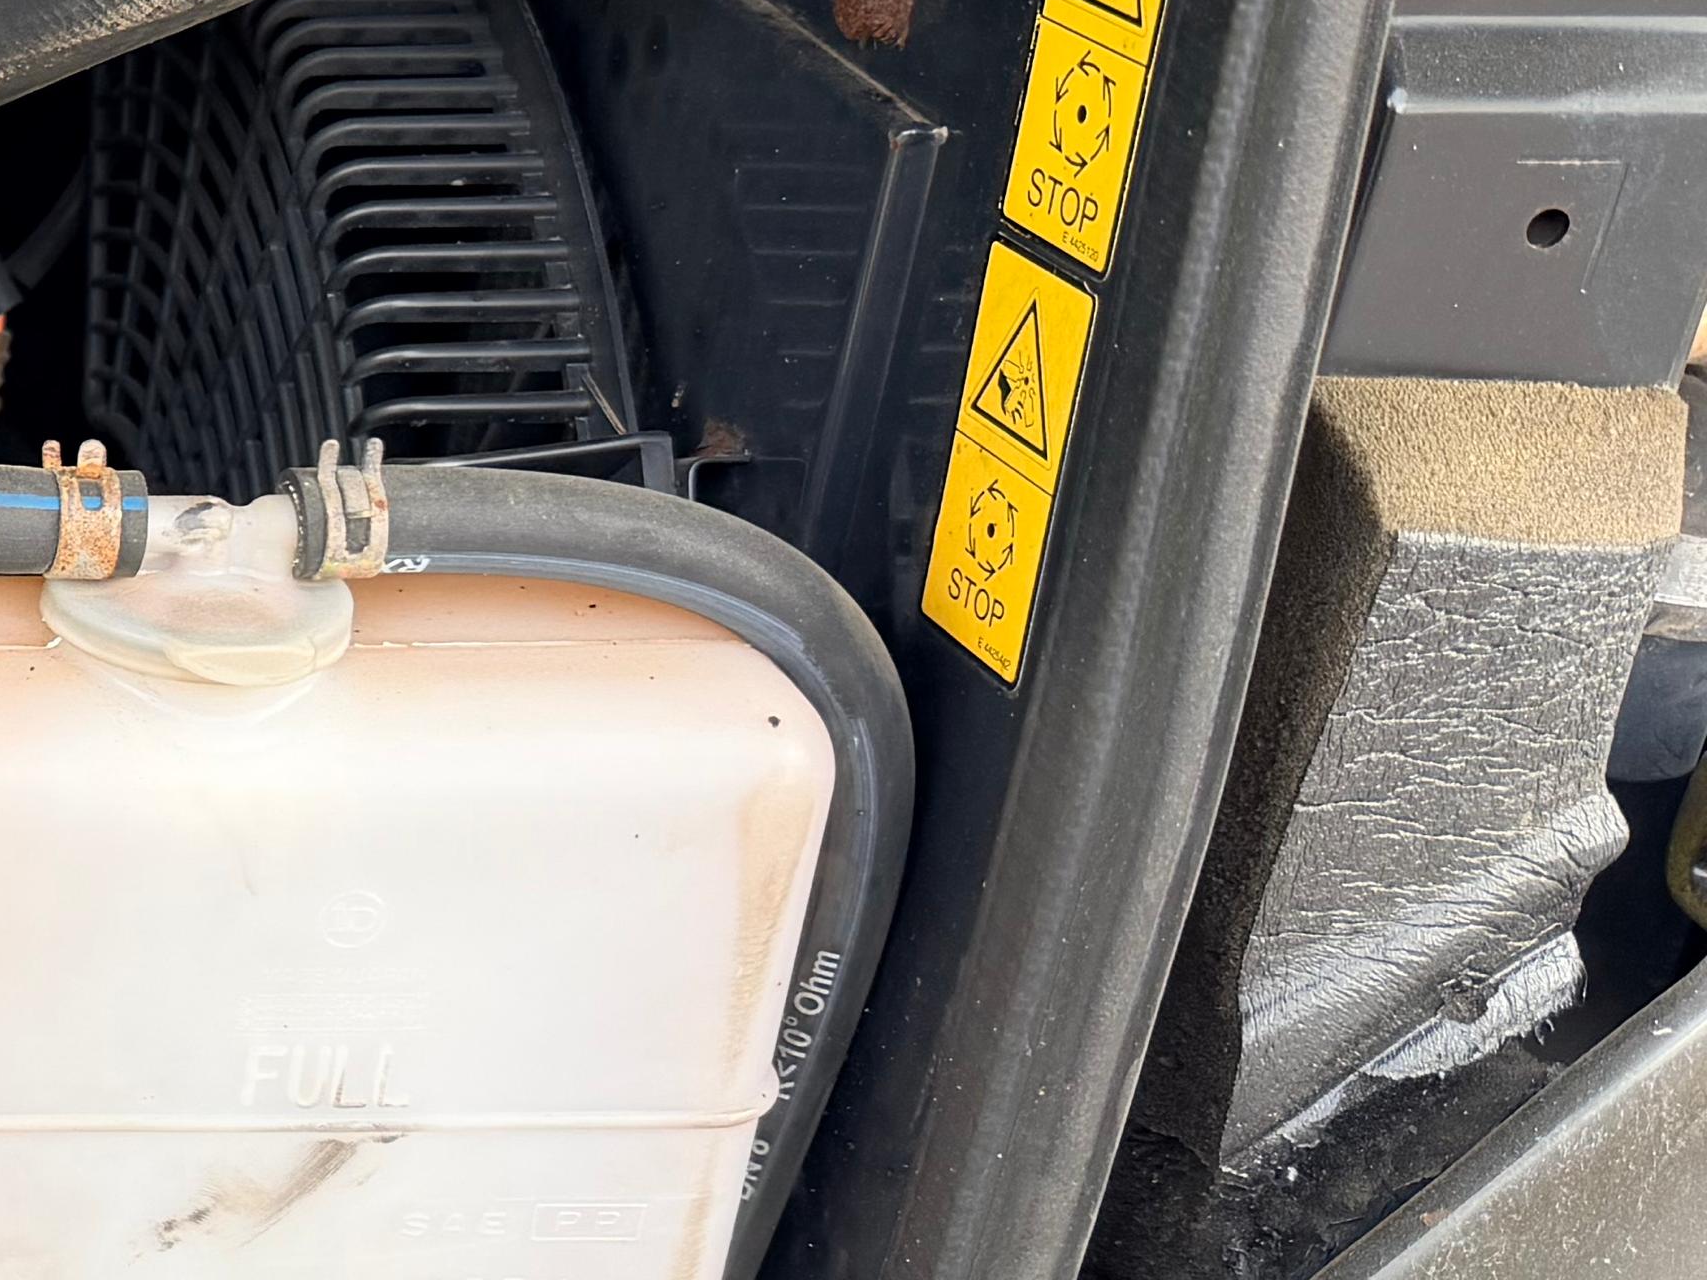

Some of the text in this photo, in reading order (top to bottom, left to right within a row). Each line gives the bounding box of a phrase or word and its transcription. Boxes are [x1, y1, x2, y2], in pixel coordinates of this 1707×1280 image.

[1027, 167, 1099, 232] STOP
[948, 567, 1005, 628] STOP
[794, 949, 841, 1016] Ohm
[239, 1042, 410, 1110] FULL
